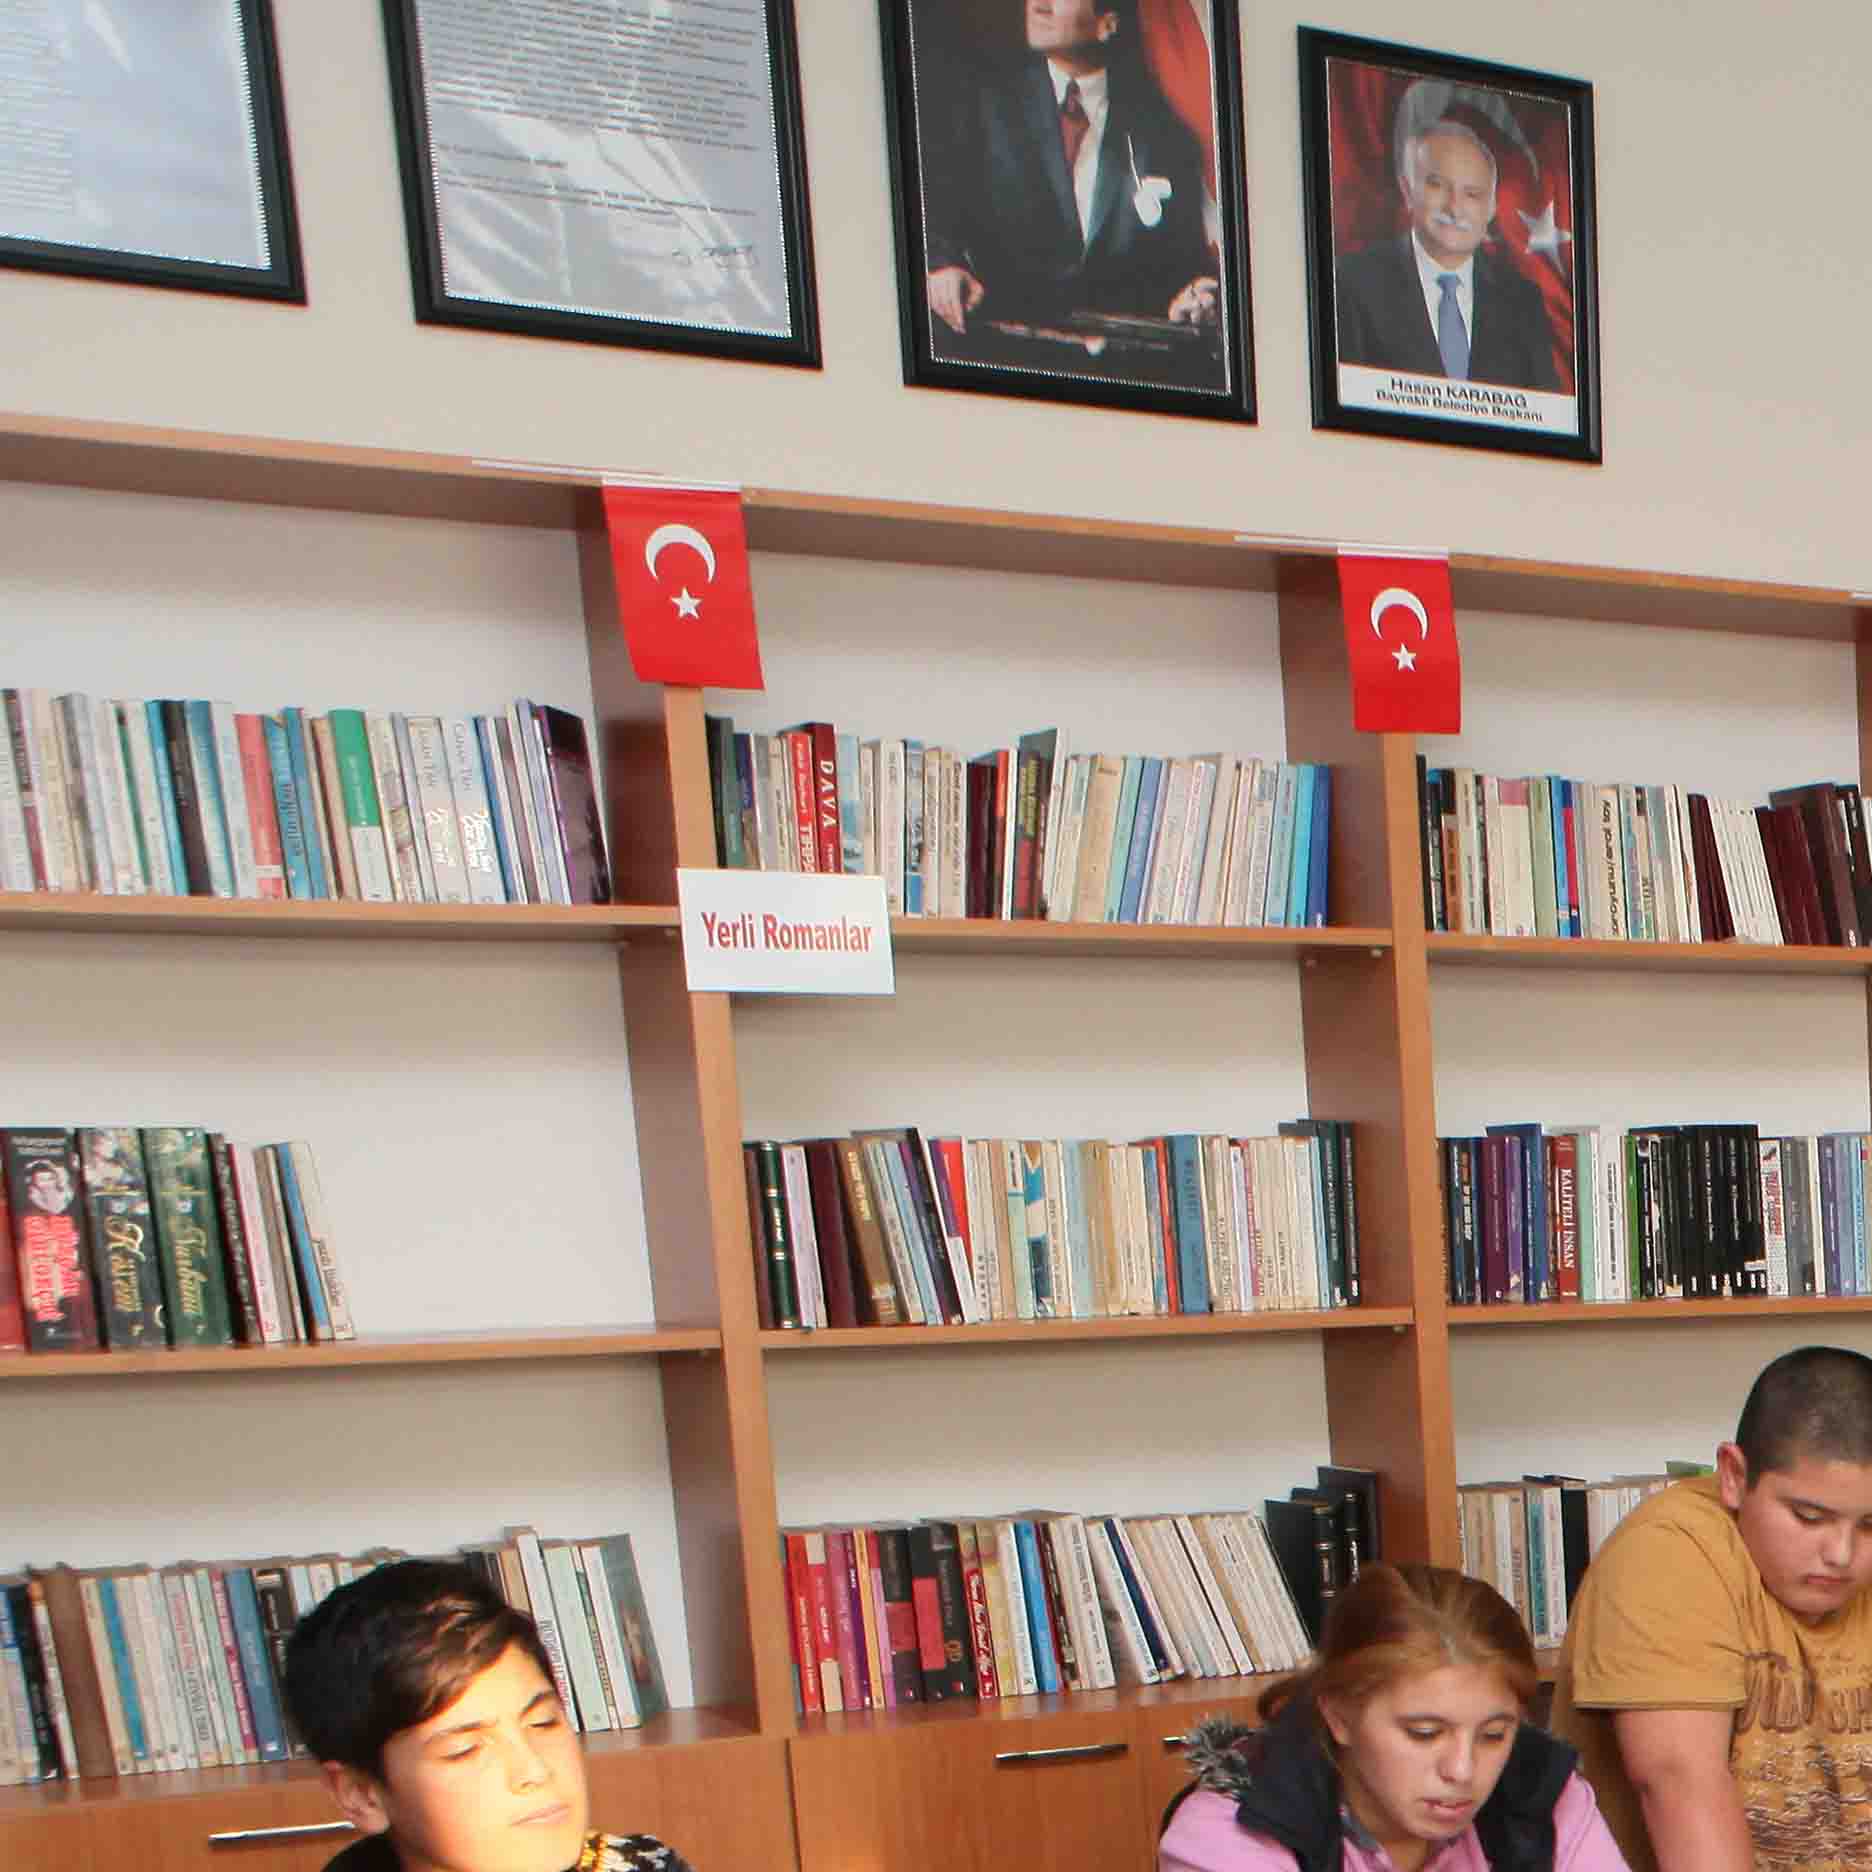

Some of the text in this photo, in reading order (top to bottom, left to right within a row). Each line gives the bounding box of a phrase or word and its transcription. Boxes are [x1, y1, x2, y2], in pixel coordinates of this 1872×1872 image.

[1391, 376, 1442, 397] Hasan
[701, 911, 873, 952] Yerli Romanlar
